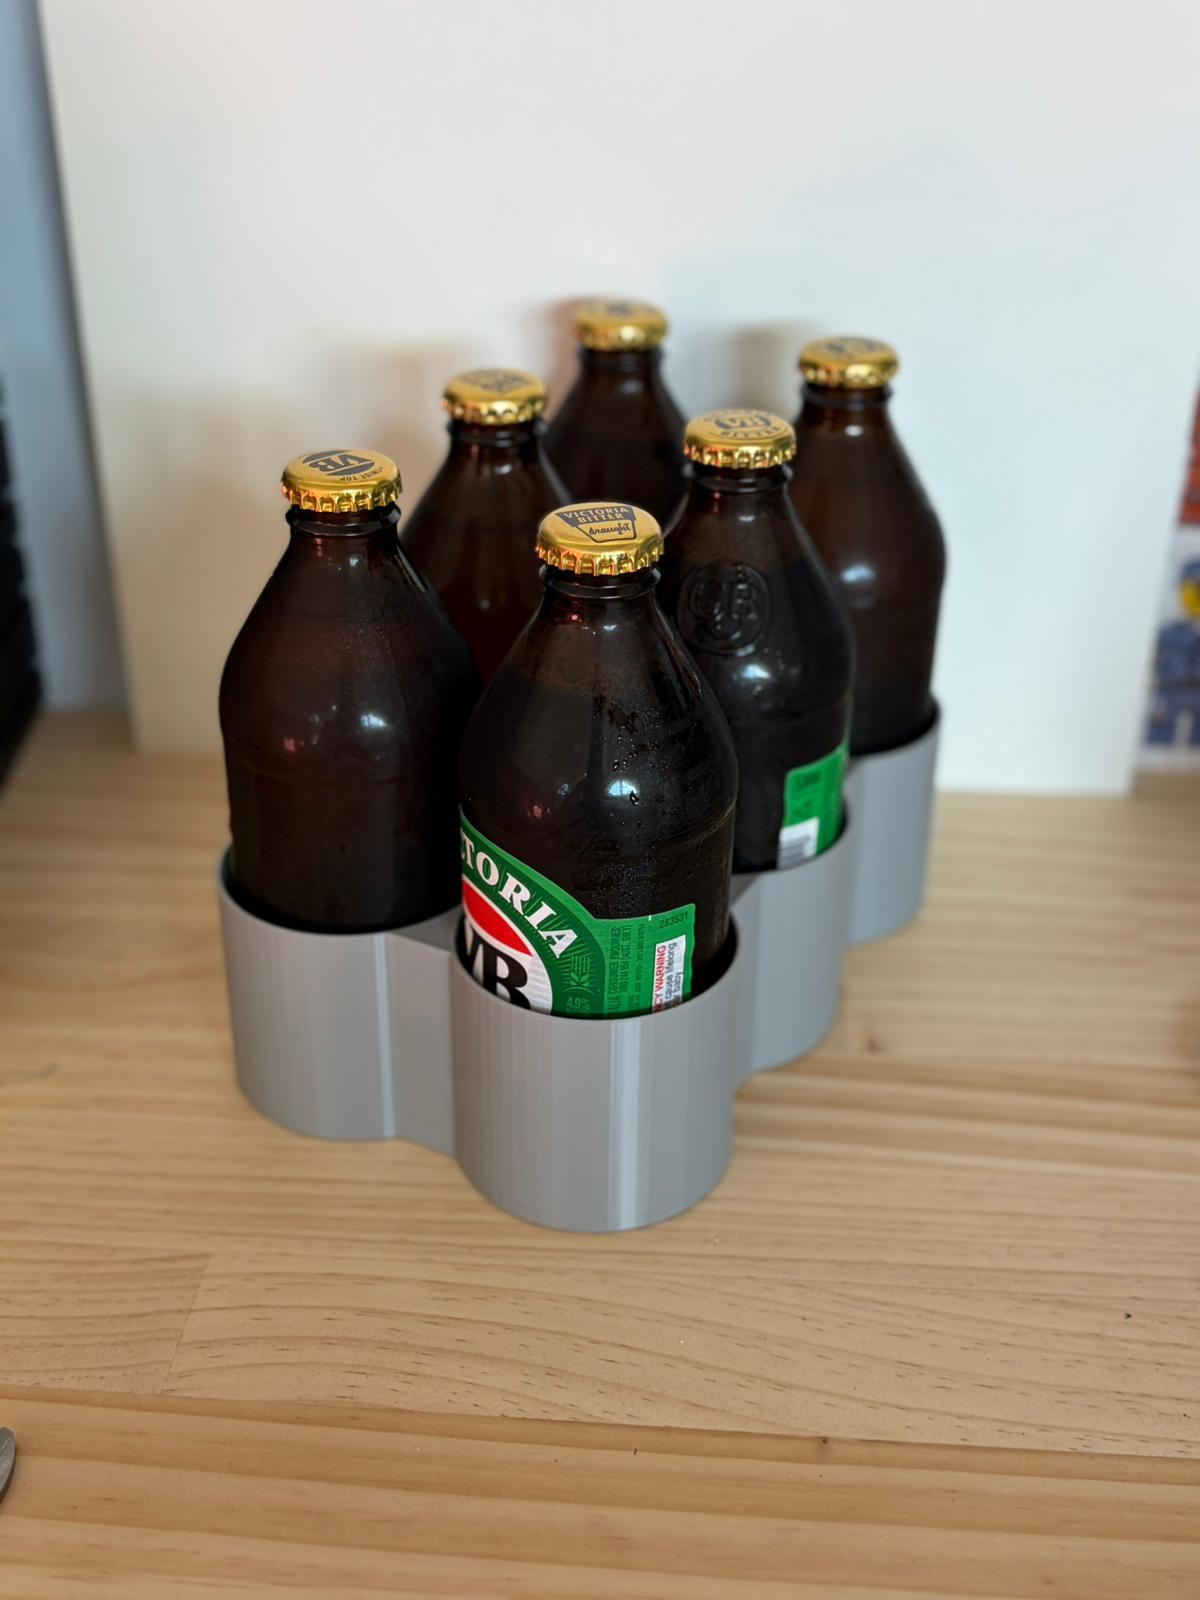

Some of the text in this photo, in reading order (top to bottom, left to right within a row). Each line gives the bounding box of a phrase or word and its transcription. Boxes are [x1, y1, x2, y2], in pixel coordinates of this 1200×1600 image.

[308, 453, 371, 472] VB
[563, 506, 629, 519] VICTORIA
[577, 513, 625, 523] BITTER
[588, 523, 631, 535] draught
[461, 833, 578, 959] TORIA
[665, 942, 677, 973] lifelong
[656, 945, 666, 992] WARNING
[665, 974, 674, 999] cause
[672, 972, 683, 992] baby
